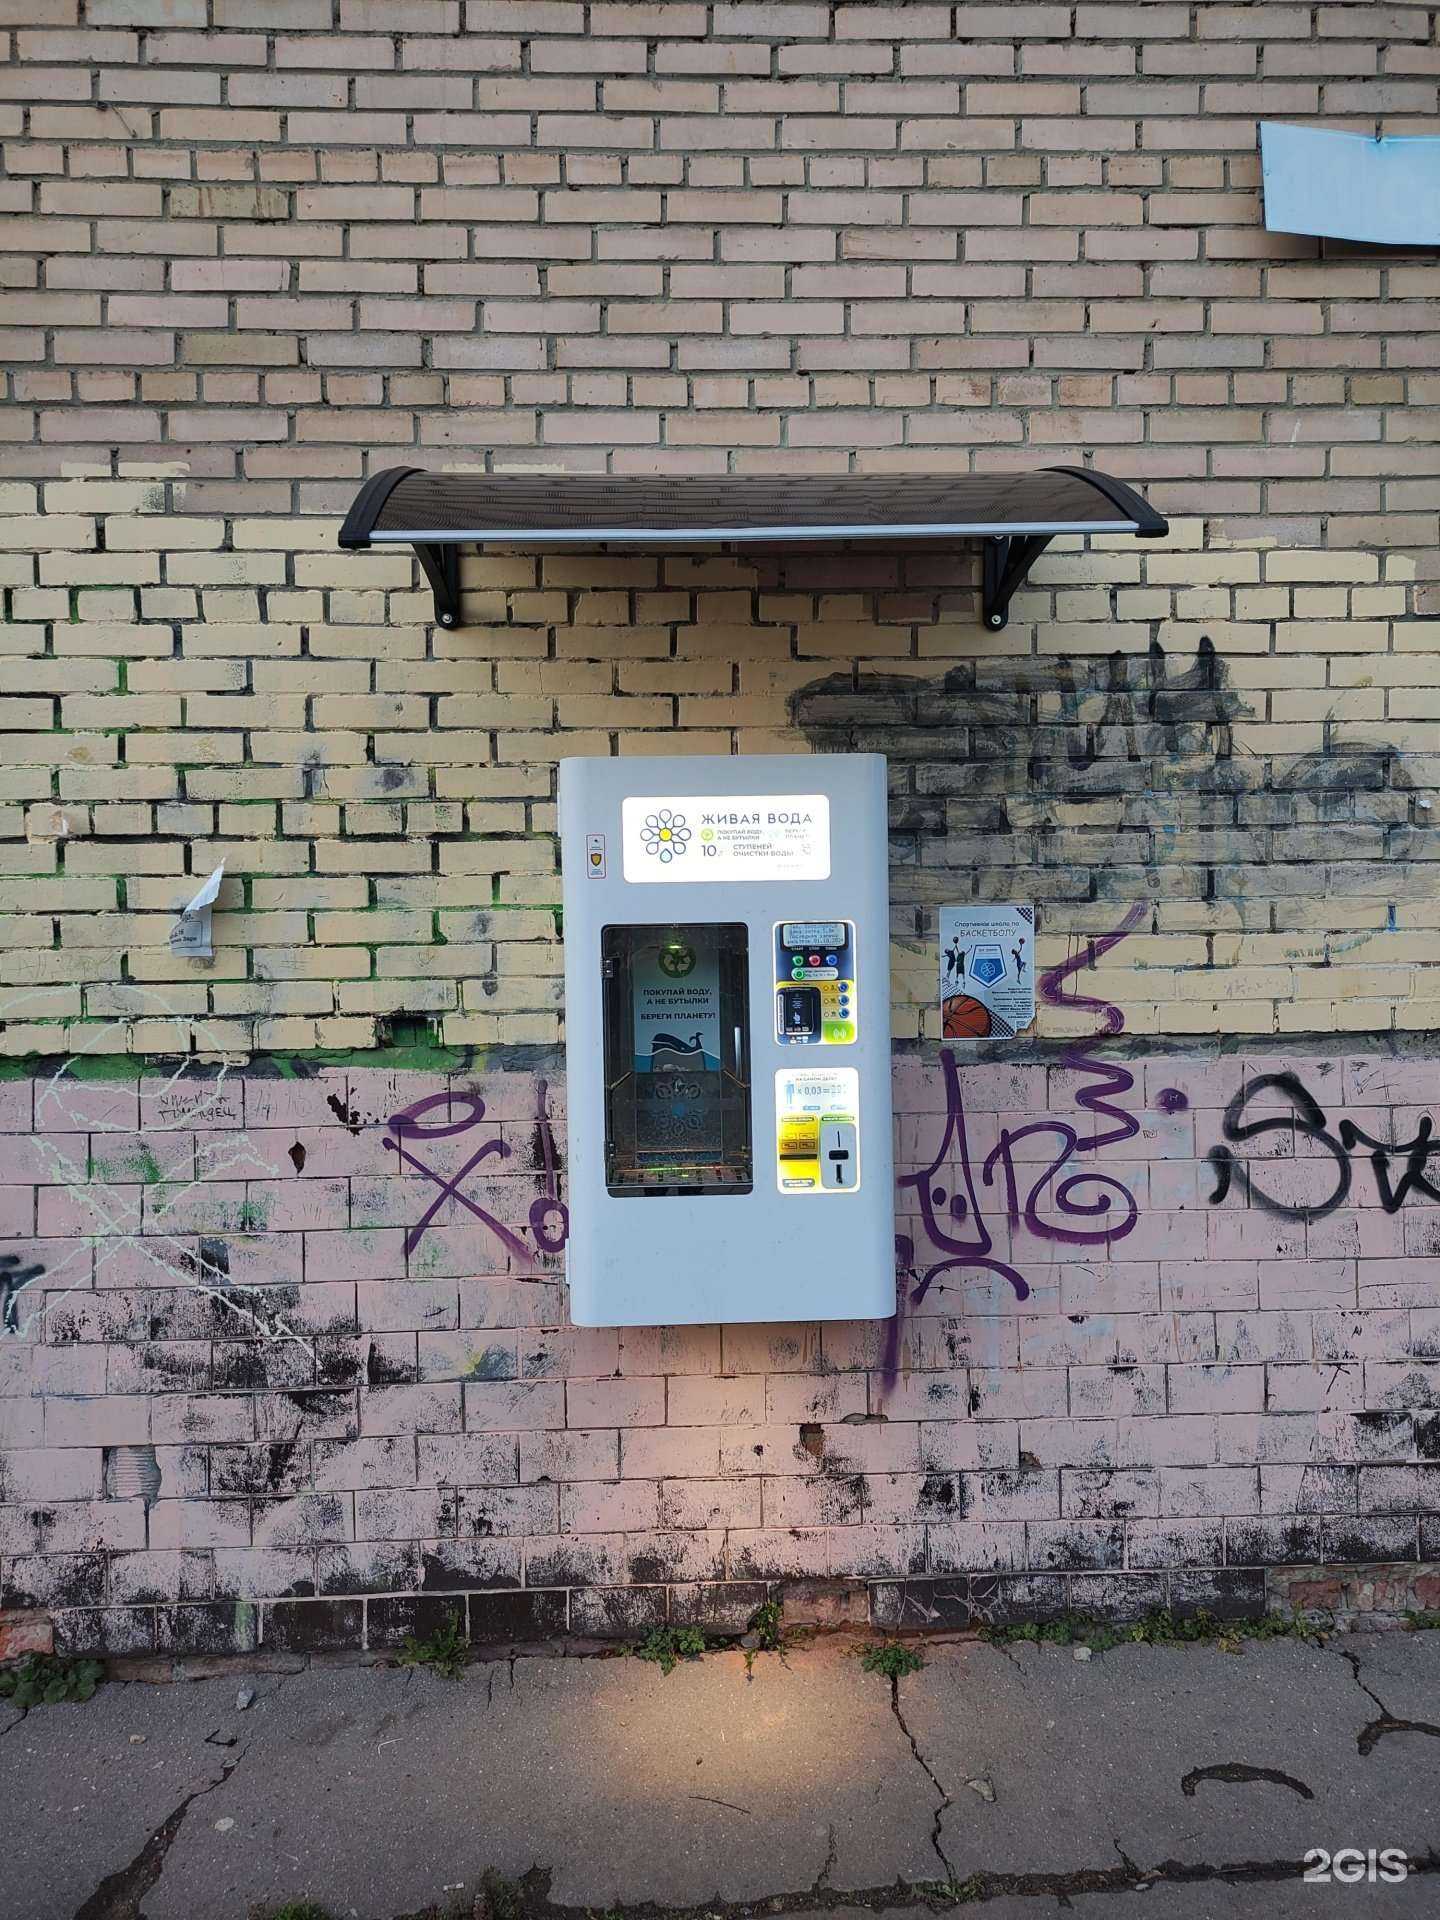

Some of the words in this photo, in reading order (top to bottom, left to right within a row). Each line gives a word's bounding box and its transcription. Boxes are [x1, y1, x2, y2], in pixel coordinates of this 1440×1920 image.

[701, 813, 760, 825] ЖИВАЯ
[767, 812, 813, 825] ВОДА
[701, 844, 717, 857] 10
[733, 842, 773, 850] СТУПЕНЕЙ
[960, 928, 1017, 937] БАСКЕТБОЛУ
[643, 987, 685, 996] ПОКУПАЙ
[668, 997, 709, 1005] БУТЫЛКИ
[640, 1012, 672, 1020] БЕРЕГИ
[674, 1012, 716, 1020] ПЛАНЕТУ!
